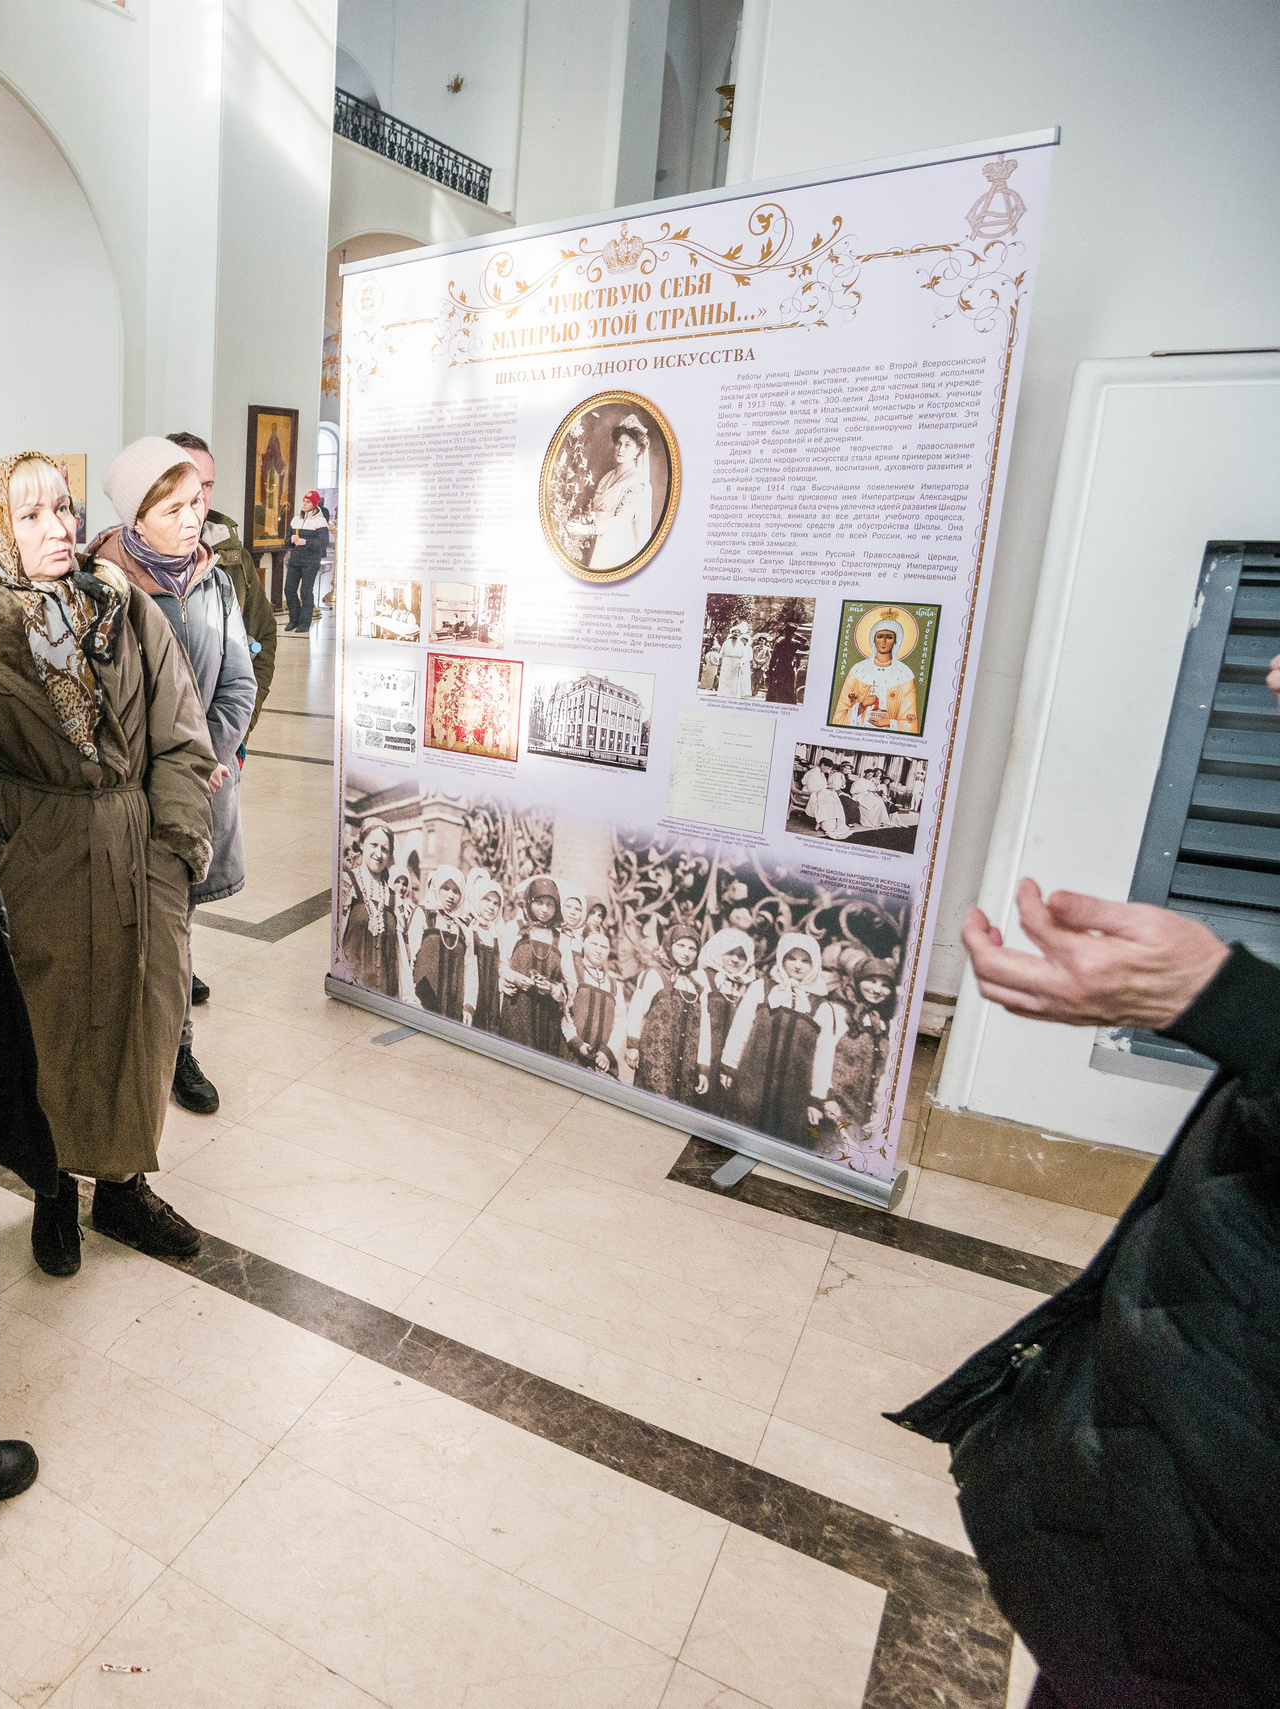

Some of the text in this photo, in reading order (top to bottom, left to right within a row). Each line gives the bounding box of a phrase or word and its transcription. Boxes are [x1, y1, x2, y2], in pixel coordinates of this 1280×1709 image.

[660, 271, 713, 301] СЕБЯ
[491, 300, 768, 351] МАТЕРЬЮ ЭТОЙ СТРАНЫ...»
[494, 347, 756, 386] ШКОЛА НАРОДНОГО ИСКУССТВА
[736, 371, 762, 382] Работы
[765, 372, 791, 382] учениц
[793, 367, 820, 378] Школы
[823, 366, 871, 378] участвовали
[888, 360, 919, 374] Второй
[921, 355, 988, 372] Всероссийской
[720, 368, 986, 394] Кустарно-промышленной выставке, ученицы постоянно исполняли
[771, 427, 791, 436] были
[794, 424, 840, 437] доработаны
[844, 421, 914, 435] собственноручно
[917, 418, 979, 432] Императрицей
[715, 437, 760, 449] Александрой
[760, 436, 807, 448] Фёдоровной
[823, 436, 864, 446] дочерями.
[713, 459, 748, 467] традиции,
[748, 456, 773, 465] Школа
[772, 457, 812, 466] народного
[811, 456, 850, 465] искусства
[873, 454, 901, 464] ярким
[900, 453, 944, 463] примером
[943, 452, 974, 460] жизне-
[712, 466, 750, 474] способной
[782, 464, 833, 475] образования,
[834, 465, 882, 474] воспитания,
[883, 464, 925, 473] духовного
[926, 463, 965, 473] развития
[711, 474, 819, 485] дальнейшей трудовой помощи.
[736, 486, 761, 494] январе
[767, 483, 785, 492] 1914
[789, 485, 807, 493] года
[811, 482, 861, 492] Высочайшим
[919, 481, 971, 493] Императора
[710, 493, 739, 501] Николая
[749, 493, 773, 501] Школе
[776, 493, 795, 501] было
[797, 495, 838, 503] присвоено
[860, 492, 917, 503] Императрицы
[918, 491, 969, 503] Александры
[707, 520, 965, 533] способствовала получению средств для обустройства Школы. Она
[705, 540, 747, 548] осуществить
[748, 538, 765, 547] свой
[703, 555, 960, 573] изображающих Святую Царственную Страстотерпицу Императрицу
[719, 547, 742, 557] Среди
[746, 549, 795, 559] современных
[824, 549, 857, 560] Русской
[862, 550, 921, 562] Православной
[926, 552, 961, 563] Церкви,
[702, 574, 732, 583] моделью
[732, 573, 757, 582] Школы
[757, 576, 795, 586] народного
[794, 578, 831, 588] искусства
[837, 580, 862, 589] руках.
[703, 564, 744, 575] Александру,
[771, 568, 817, 578] встречаются
[820, 568, 873, 580] изображения
[902, 570, 958, 583] уменьшенной
[799, 869, 911, 896] ИМПЕРАТРИЦЫ АЛЕКСАНДРЫ ФЁДОРОВНЫ
[801, 863, 911, 889] УЧЕНИЦЫ ШКОЛЫ НАРОДНОГО ИСКУССТВА
[824, 879, 848, 889] РУССКИХ
[848, 884, 879, 896] НАРОДНЫХ
[879, 890, 909, 901] КОСТЮМАХ
